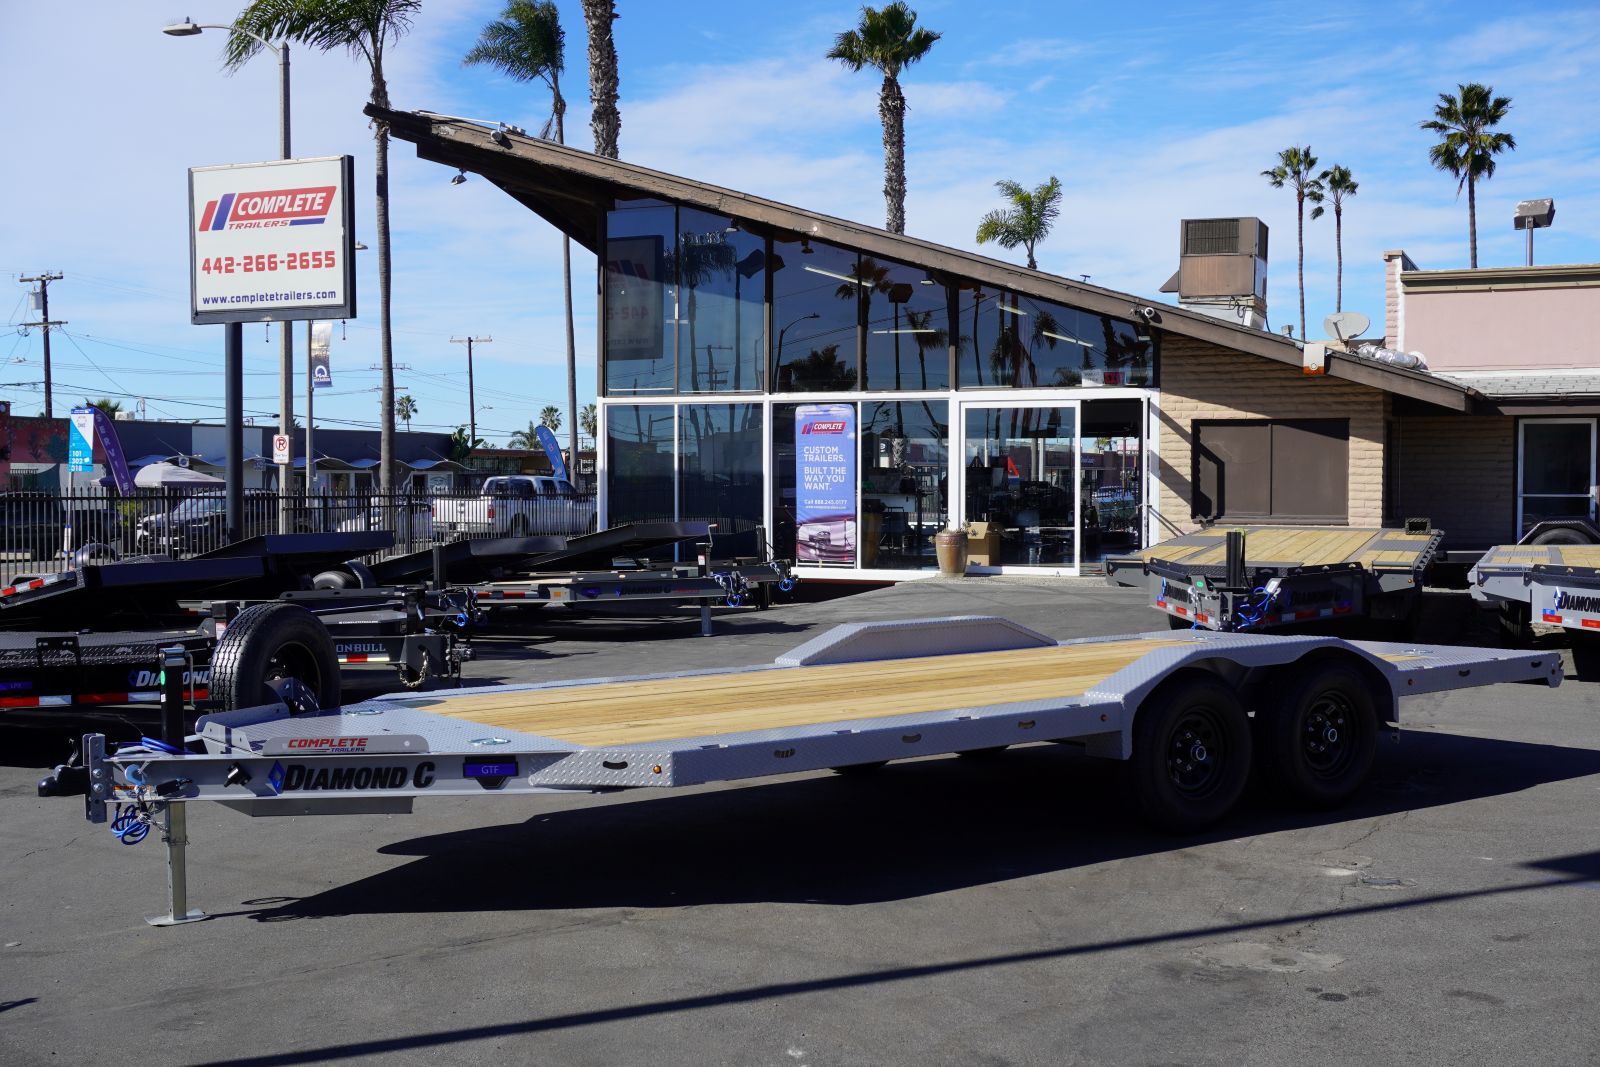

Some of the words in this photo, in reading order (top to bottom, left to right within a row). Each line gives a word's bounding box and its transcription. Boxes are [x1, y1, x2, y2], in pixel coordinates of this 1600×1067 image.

[237, 193, 326, 216] COMPLETE
[228, 220, 290, 230] TRAILERS
[201, 250, 336, 274] 442-266-2655
[202, 290, 337, 305] www.completetrailers.com
[803, 446, 839, 454] CUSTOM
[804, 454, 846, 462] TRAILERS.
[287, 738, 368, 748] COMPLETE
[481, 765, 500, 774] GTF
[283, 763, 408, 791] DIAMOND
[413, 761, 436, 788] C
